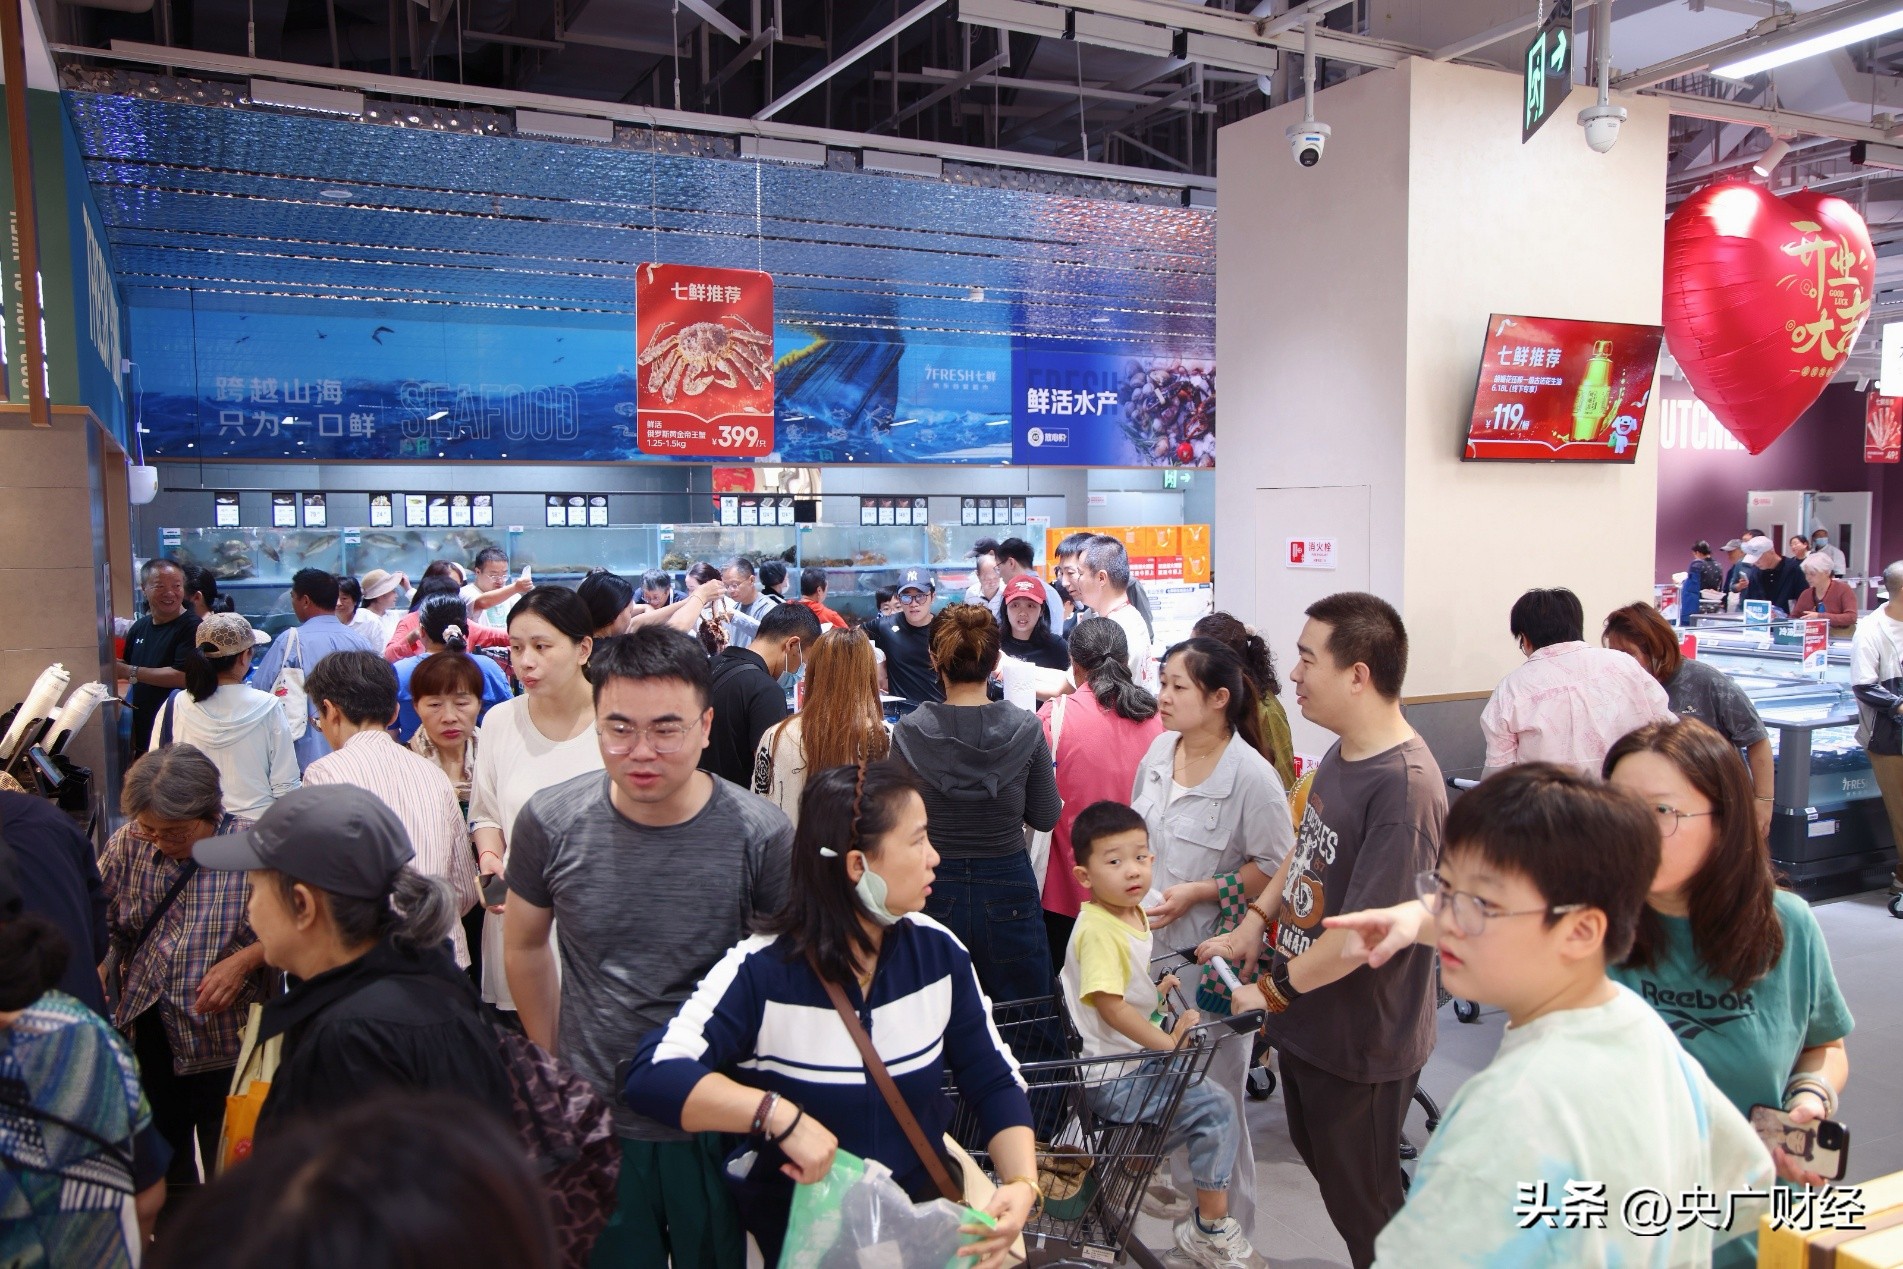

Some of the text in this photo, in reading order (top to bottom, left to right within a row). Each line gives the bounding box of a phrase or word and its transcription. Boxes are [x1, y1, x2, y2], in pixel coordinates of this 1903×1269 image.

[671, 281, 742, 304] 七鲜推荐
[1829, 289, 1844, 297] GOOD
[1834, 297, 1848, 306] LUCK
[1497, 345, 1562, 368] 七鲜推荐
[216, 376, 343, 405] 跨越山海
[1027, 387, 1118, 417] 鲜活水产
[401, 381, 579, 441] SEAFOOD
[218, 410, 376, 438] 只为一口鲜
[646, 420, 663, 429] 鲜活
[646, 439, 687, 449] 1.25-1.5kg
[1308, 541, 1332, 552] 消火栓
[1641, 979, 1755, 1010] Reebok
